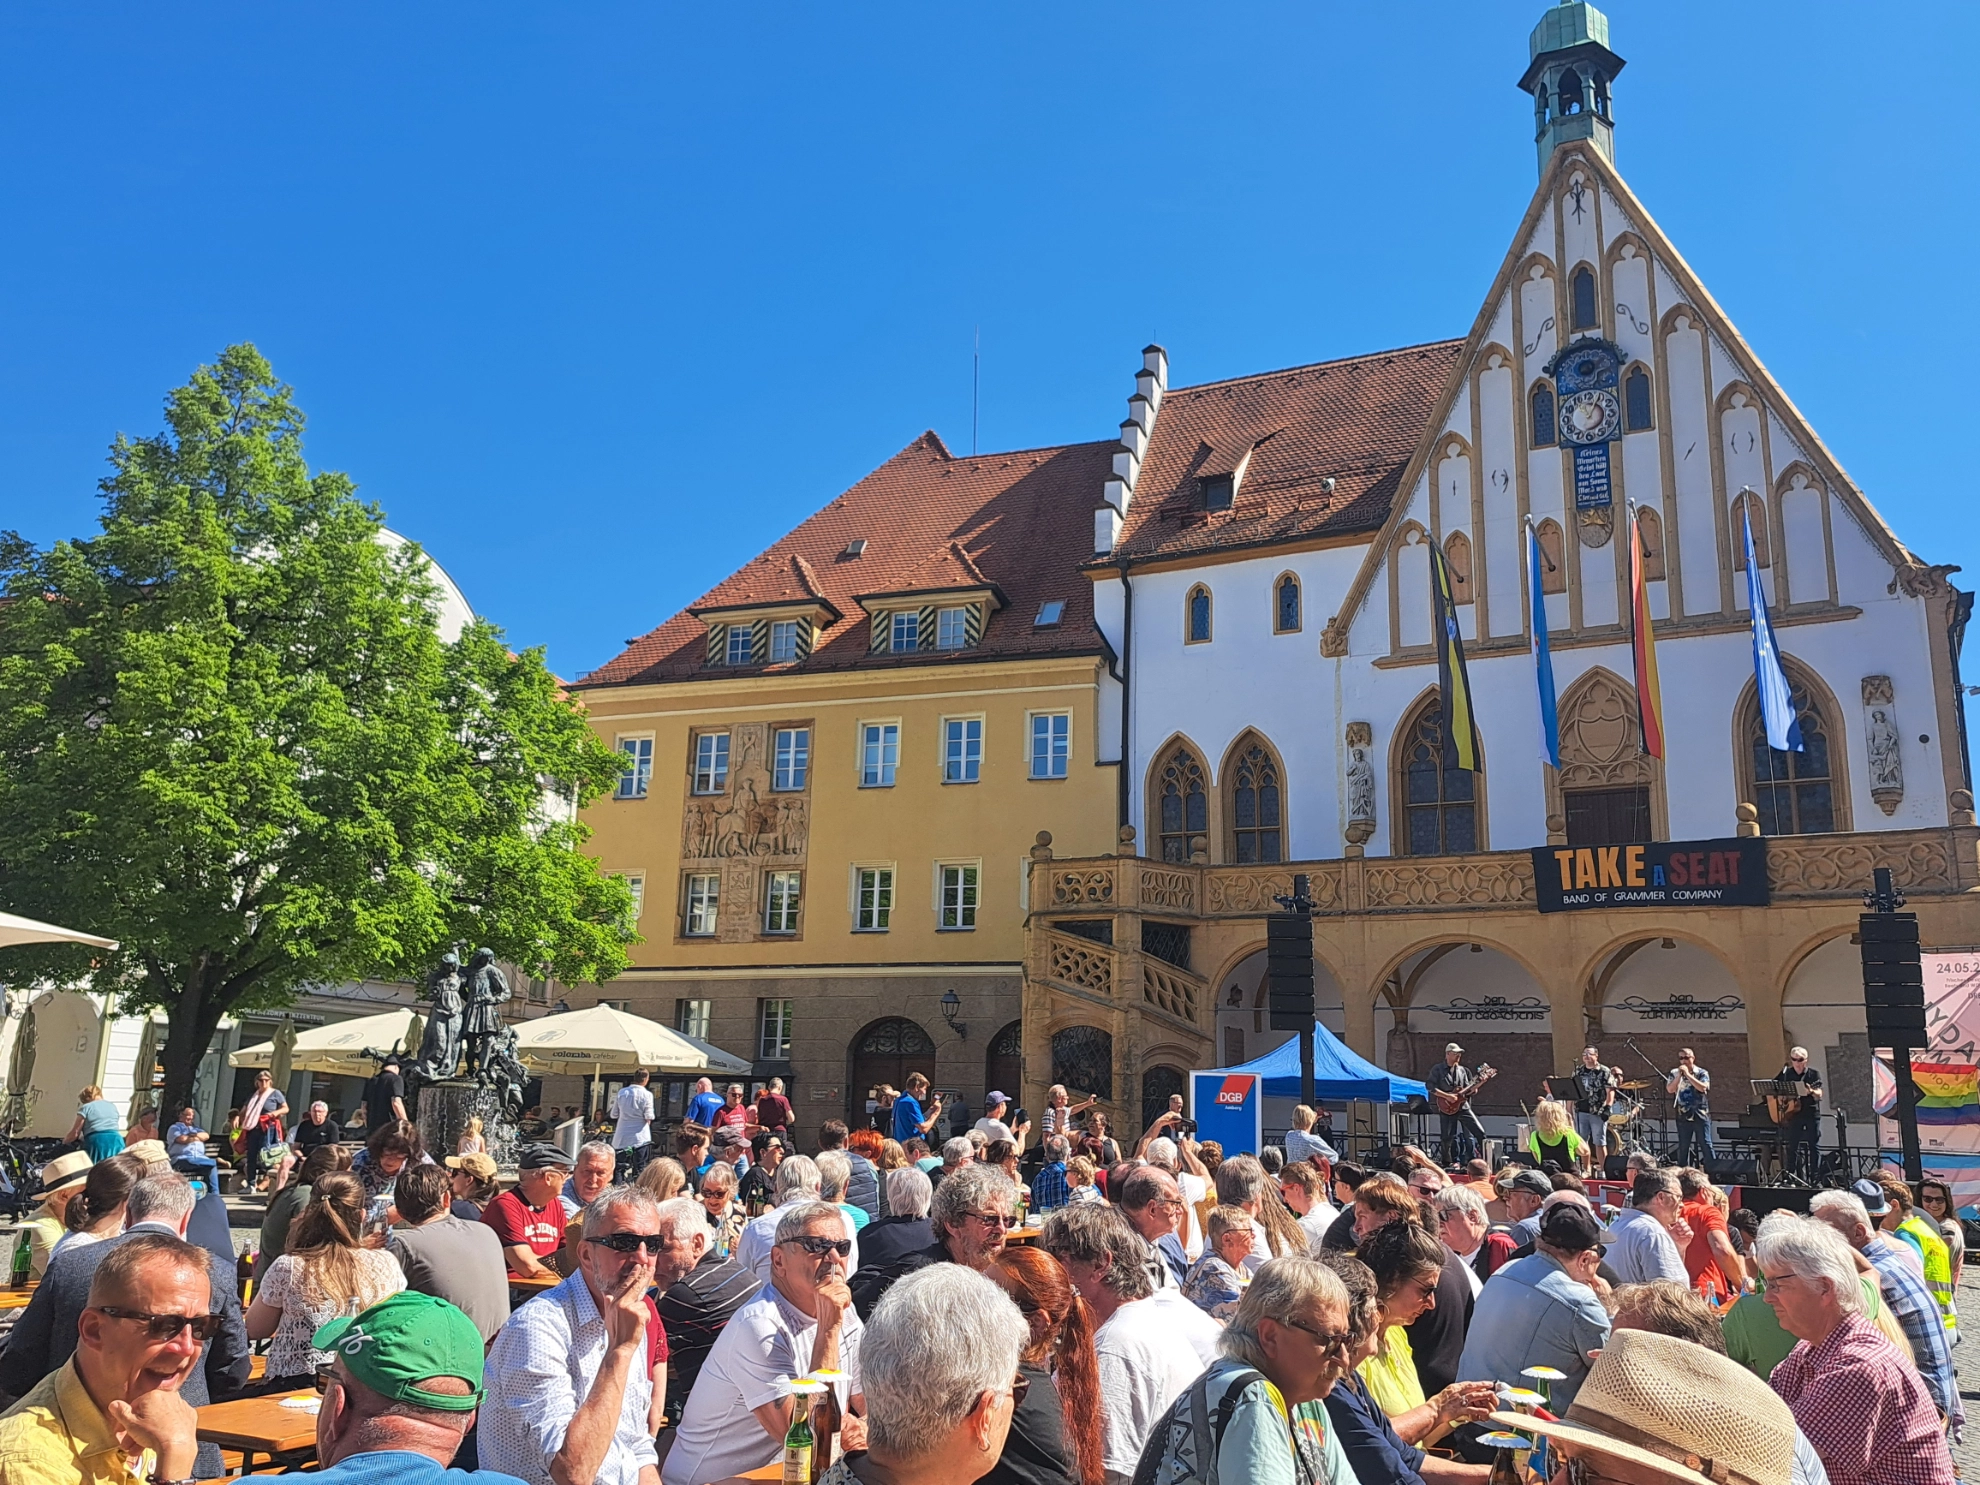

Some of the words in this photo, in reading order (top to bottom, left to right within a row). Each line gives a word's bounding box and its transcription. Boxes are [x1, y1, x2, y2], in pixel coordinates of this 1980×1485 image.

[1583, 392, 1594, 400] 12
[1605, 399, 1614, 408] 2
[1565, 405, 1574, 414] 10
[1607, 409, 1617, 418] 3
[1562, 415, 1570, 425] 9
[1566, 425, 1575, 434] 8
[1596, 428, 1606, 437] 5
[1574, 432, 1583, 440] 7
[1586, 432, 1595, 441] 6
[1554, 845, 1646, 891] TAKE
[1653, 864, 1666, 887] A
[1669, 851, 1741, 886] SEAT
[1563, 893, 1590, 904] BAND
[1594, 892, 1608, 902] OF
[1614, 890, 1666, 902] GRAMMER
[1672, 889, 1724, 900] COMPANY
[552, 1051, 592, 1059] colomba
[1220, 1092, 1243, 1102] DGB
